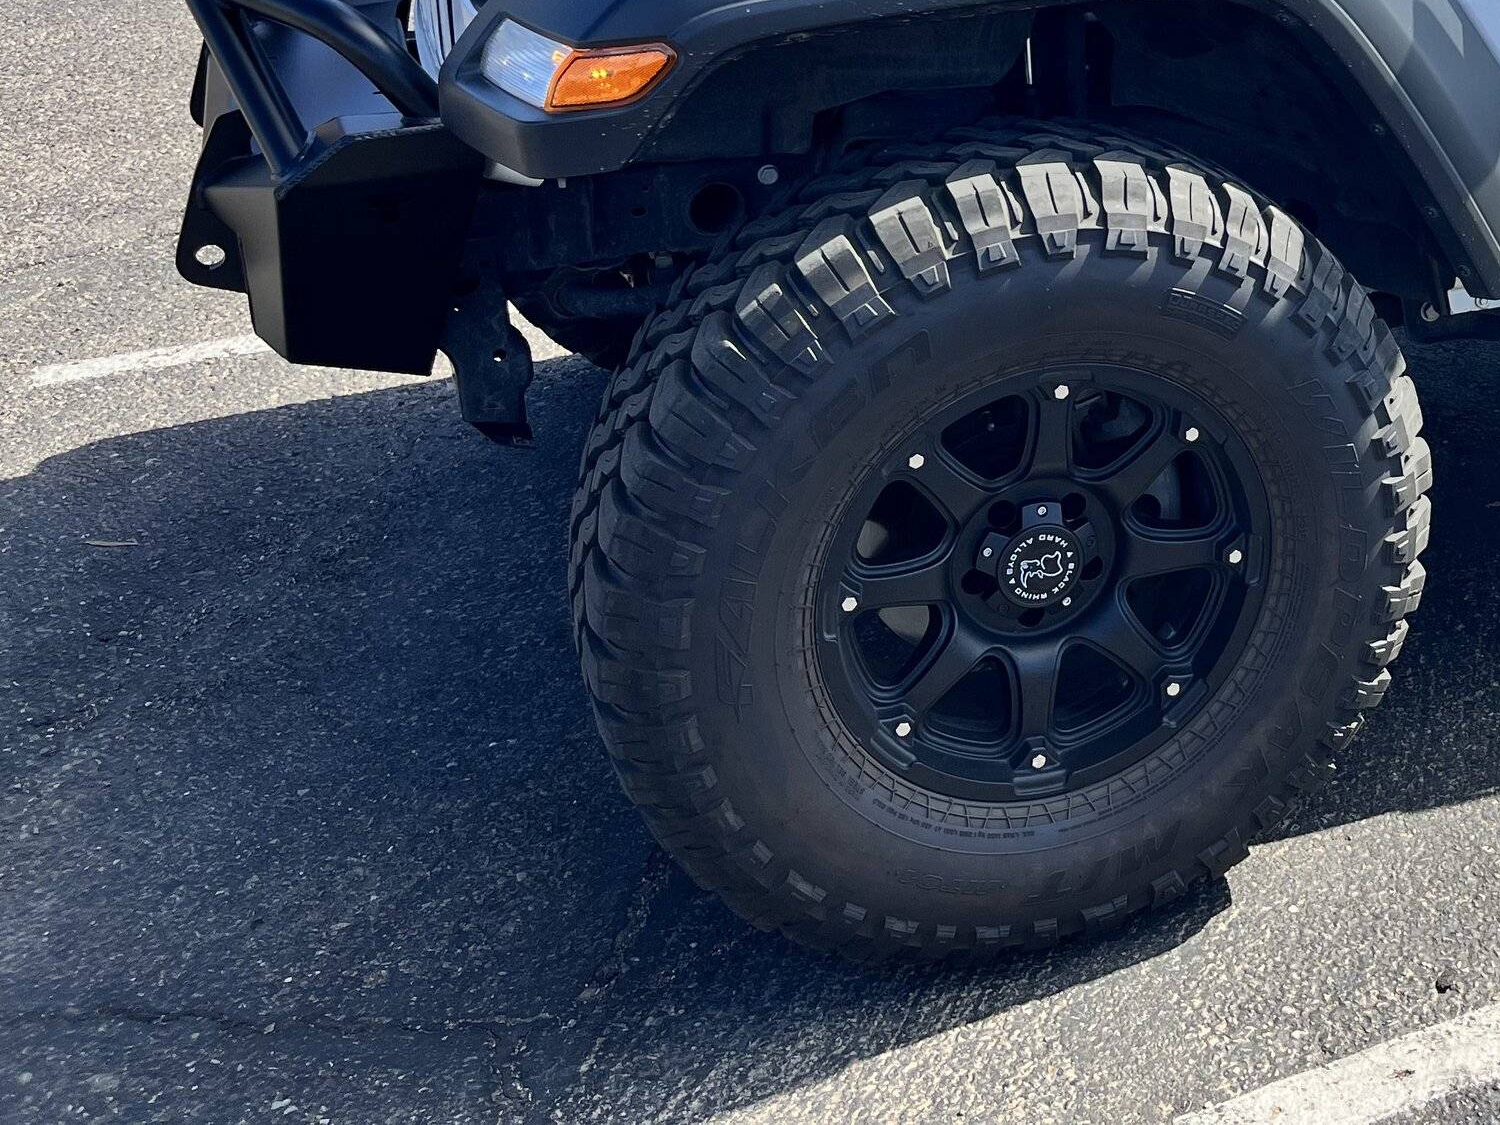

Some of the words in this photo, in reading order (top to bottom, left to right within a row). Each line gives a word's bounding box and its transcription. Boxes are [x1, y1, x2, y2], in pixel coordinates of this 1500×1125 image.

[1038, 534, 1068, 548] HARD
[1006, 537, 1033, 575] ALLOYS
[1052, 562, 1075, 594] BLACK
[1014, 587, 1048, 600] RHINO
